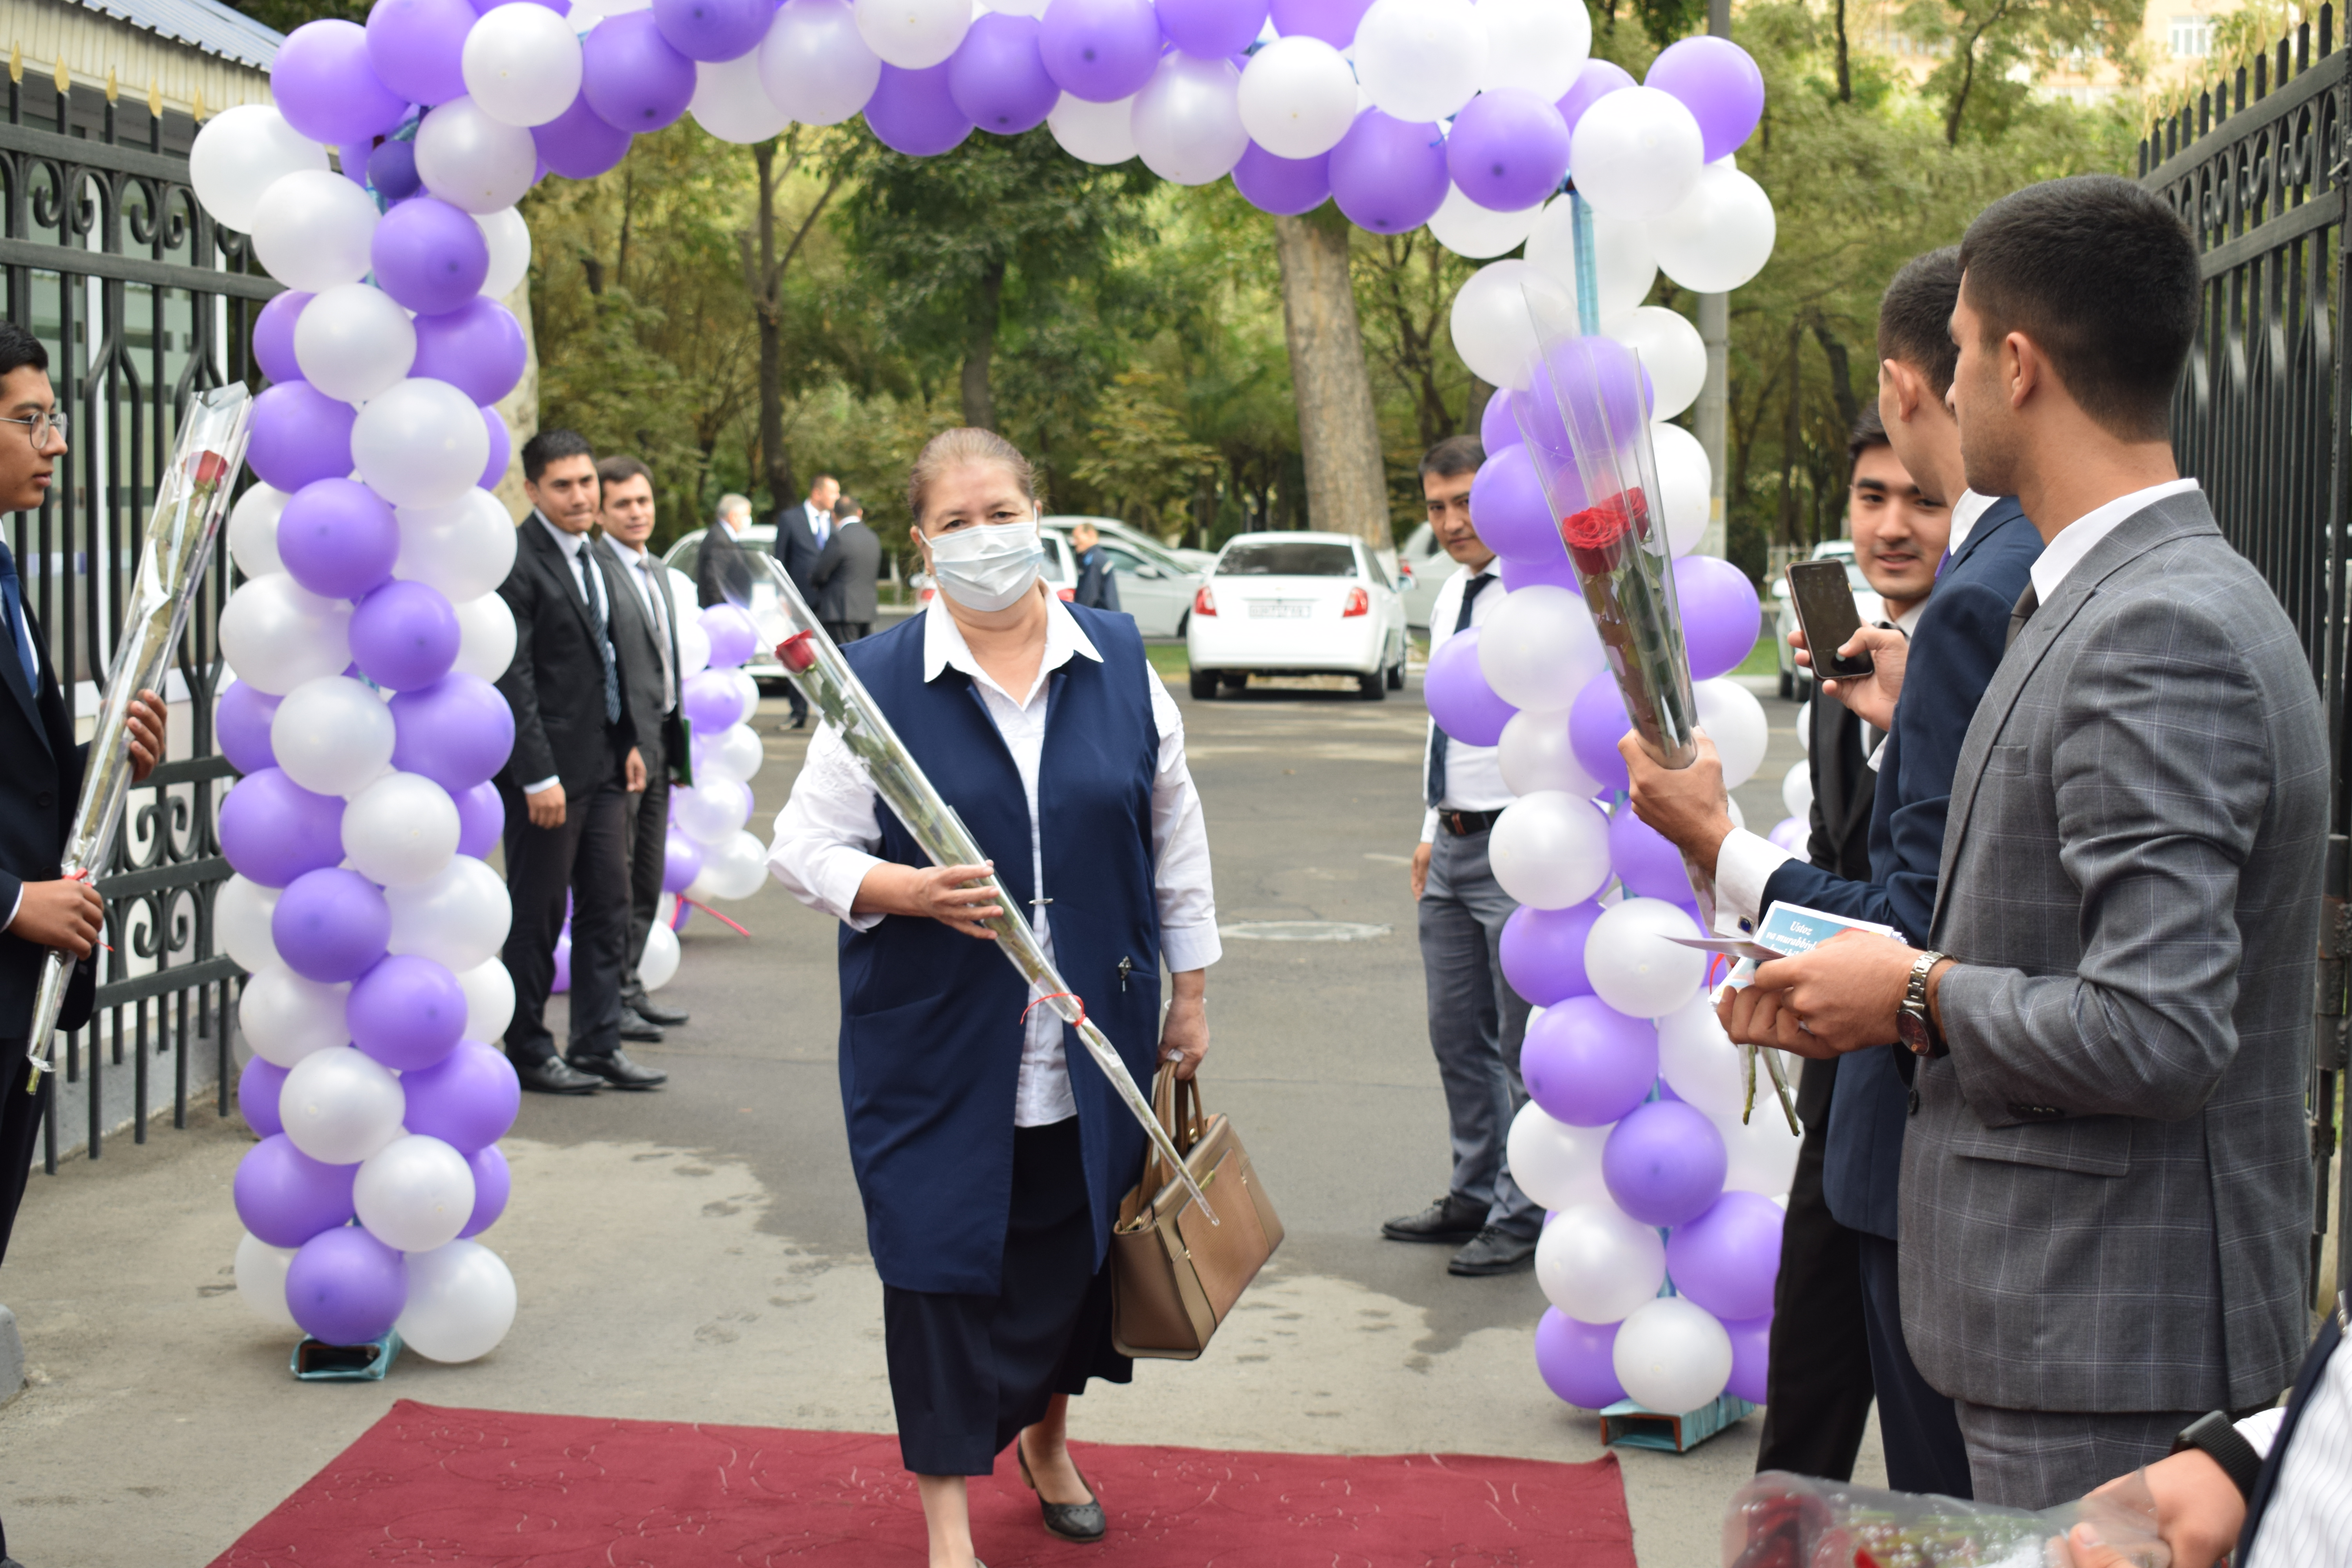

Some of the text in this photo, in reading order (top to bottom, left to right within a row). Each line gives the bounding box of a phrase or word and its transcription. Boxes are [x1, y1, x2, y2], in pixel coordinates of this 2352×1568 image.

[1790, 921, 1813, 936] Ustoz
[1766, 931, 1818, 951] va murabbiyl
